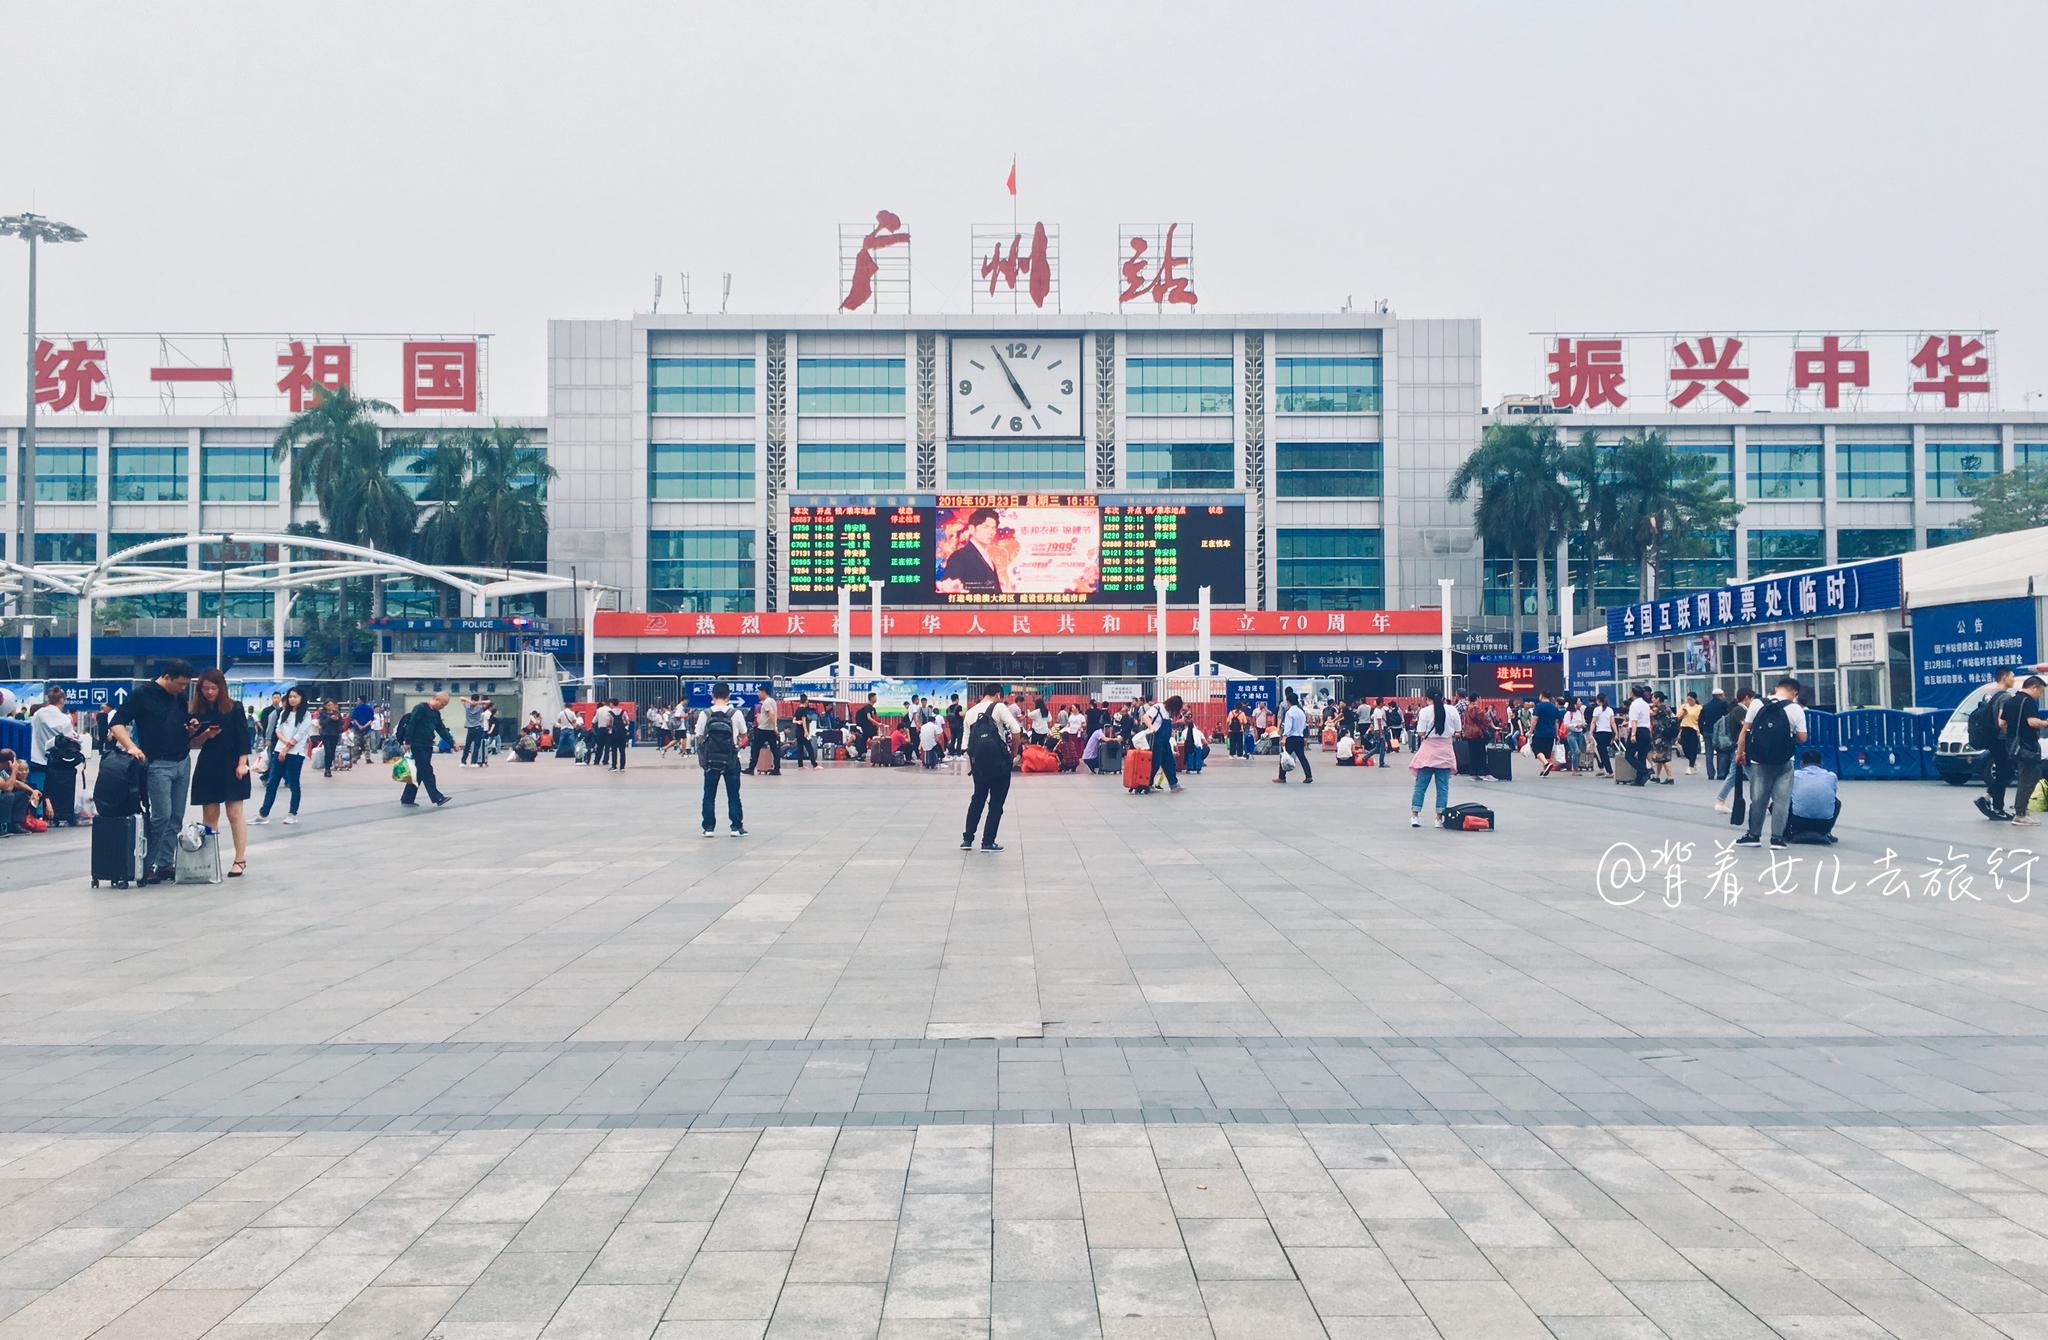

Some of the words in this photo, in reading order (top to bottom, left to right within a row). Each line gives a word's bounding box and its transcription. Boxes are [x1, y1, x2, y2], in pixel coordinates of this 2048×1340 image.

[839, 209, 1199, 311] 广州站
[1005, 343, 1027, 358] 12
[34, 340, 477, 412] 统一祖国
[1547, 335, 1991, 408] 振兴中华
[959, 380, 972, 395] 9
[1060, 379, 1073, 395] 3
[1009, 416, 1023, 432] 6
[938, 495, 1019, 506] 2019年10月23日
[1026, 495, 1060, 506] 星期三
[1066, 496, 1096, 506] 16:55
[462, 620, 494, 628] POLICE
[1957, 617, 1983, 634] 公告
[266, 640, 300, 648] 西站口
[1466, 634, 1494, 643] 小红帽
[1497, 667, 1533, 679] 进站口
